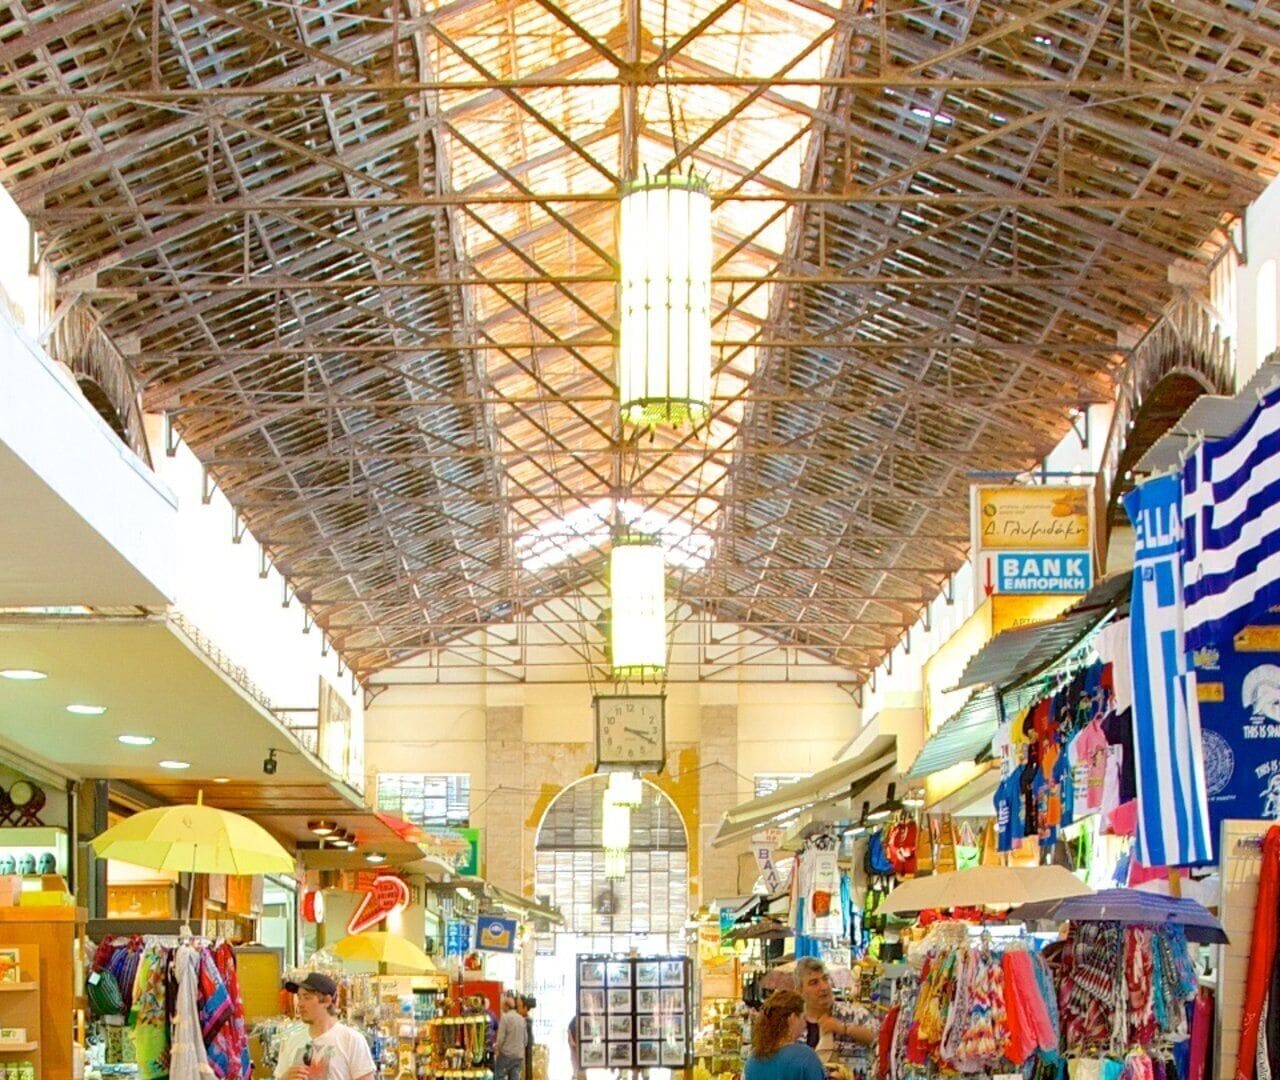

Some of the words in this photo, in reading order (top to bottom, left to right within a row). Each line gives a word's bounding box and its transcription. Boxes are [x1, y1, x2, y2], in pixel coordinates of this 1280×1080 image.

[1003, 558, 1083, 577] BANK
[1004, 577, 1085, 590] ΕΜΠΟΡΙΚΗ
[1243, 725, 1258, 739] THIS
[1259, 725, 1266, 739] IS
[1255, 762, 1271, 779] THIS
